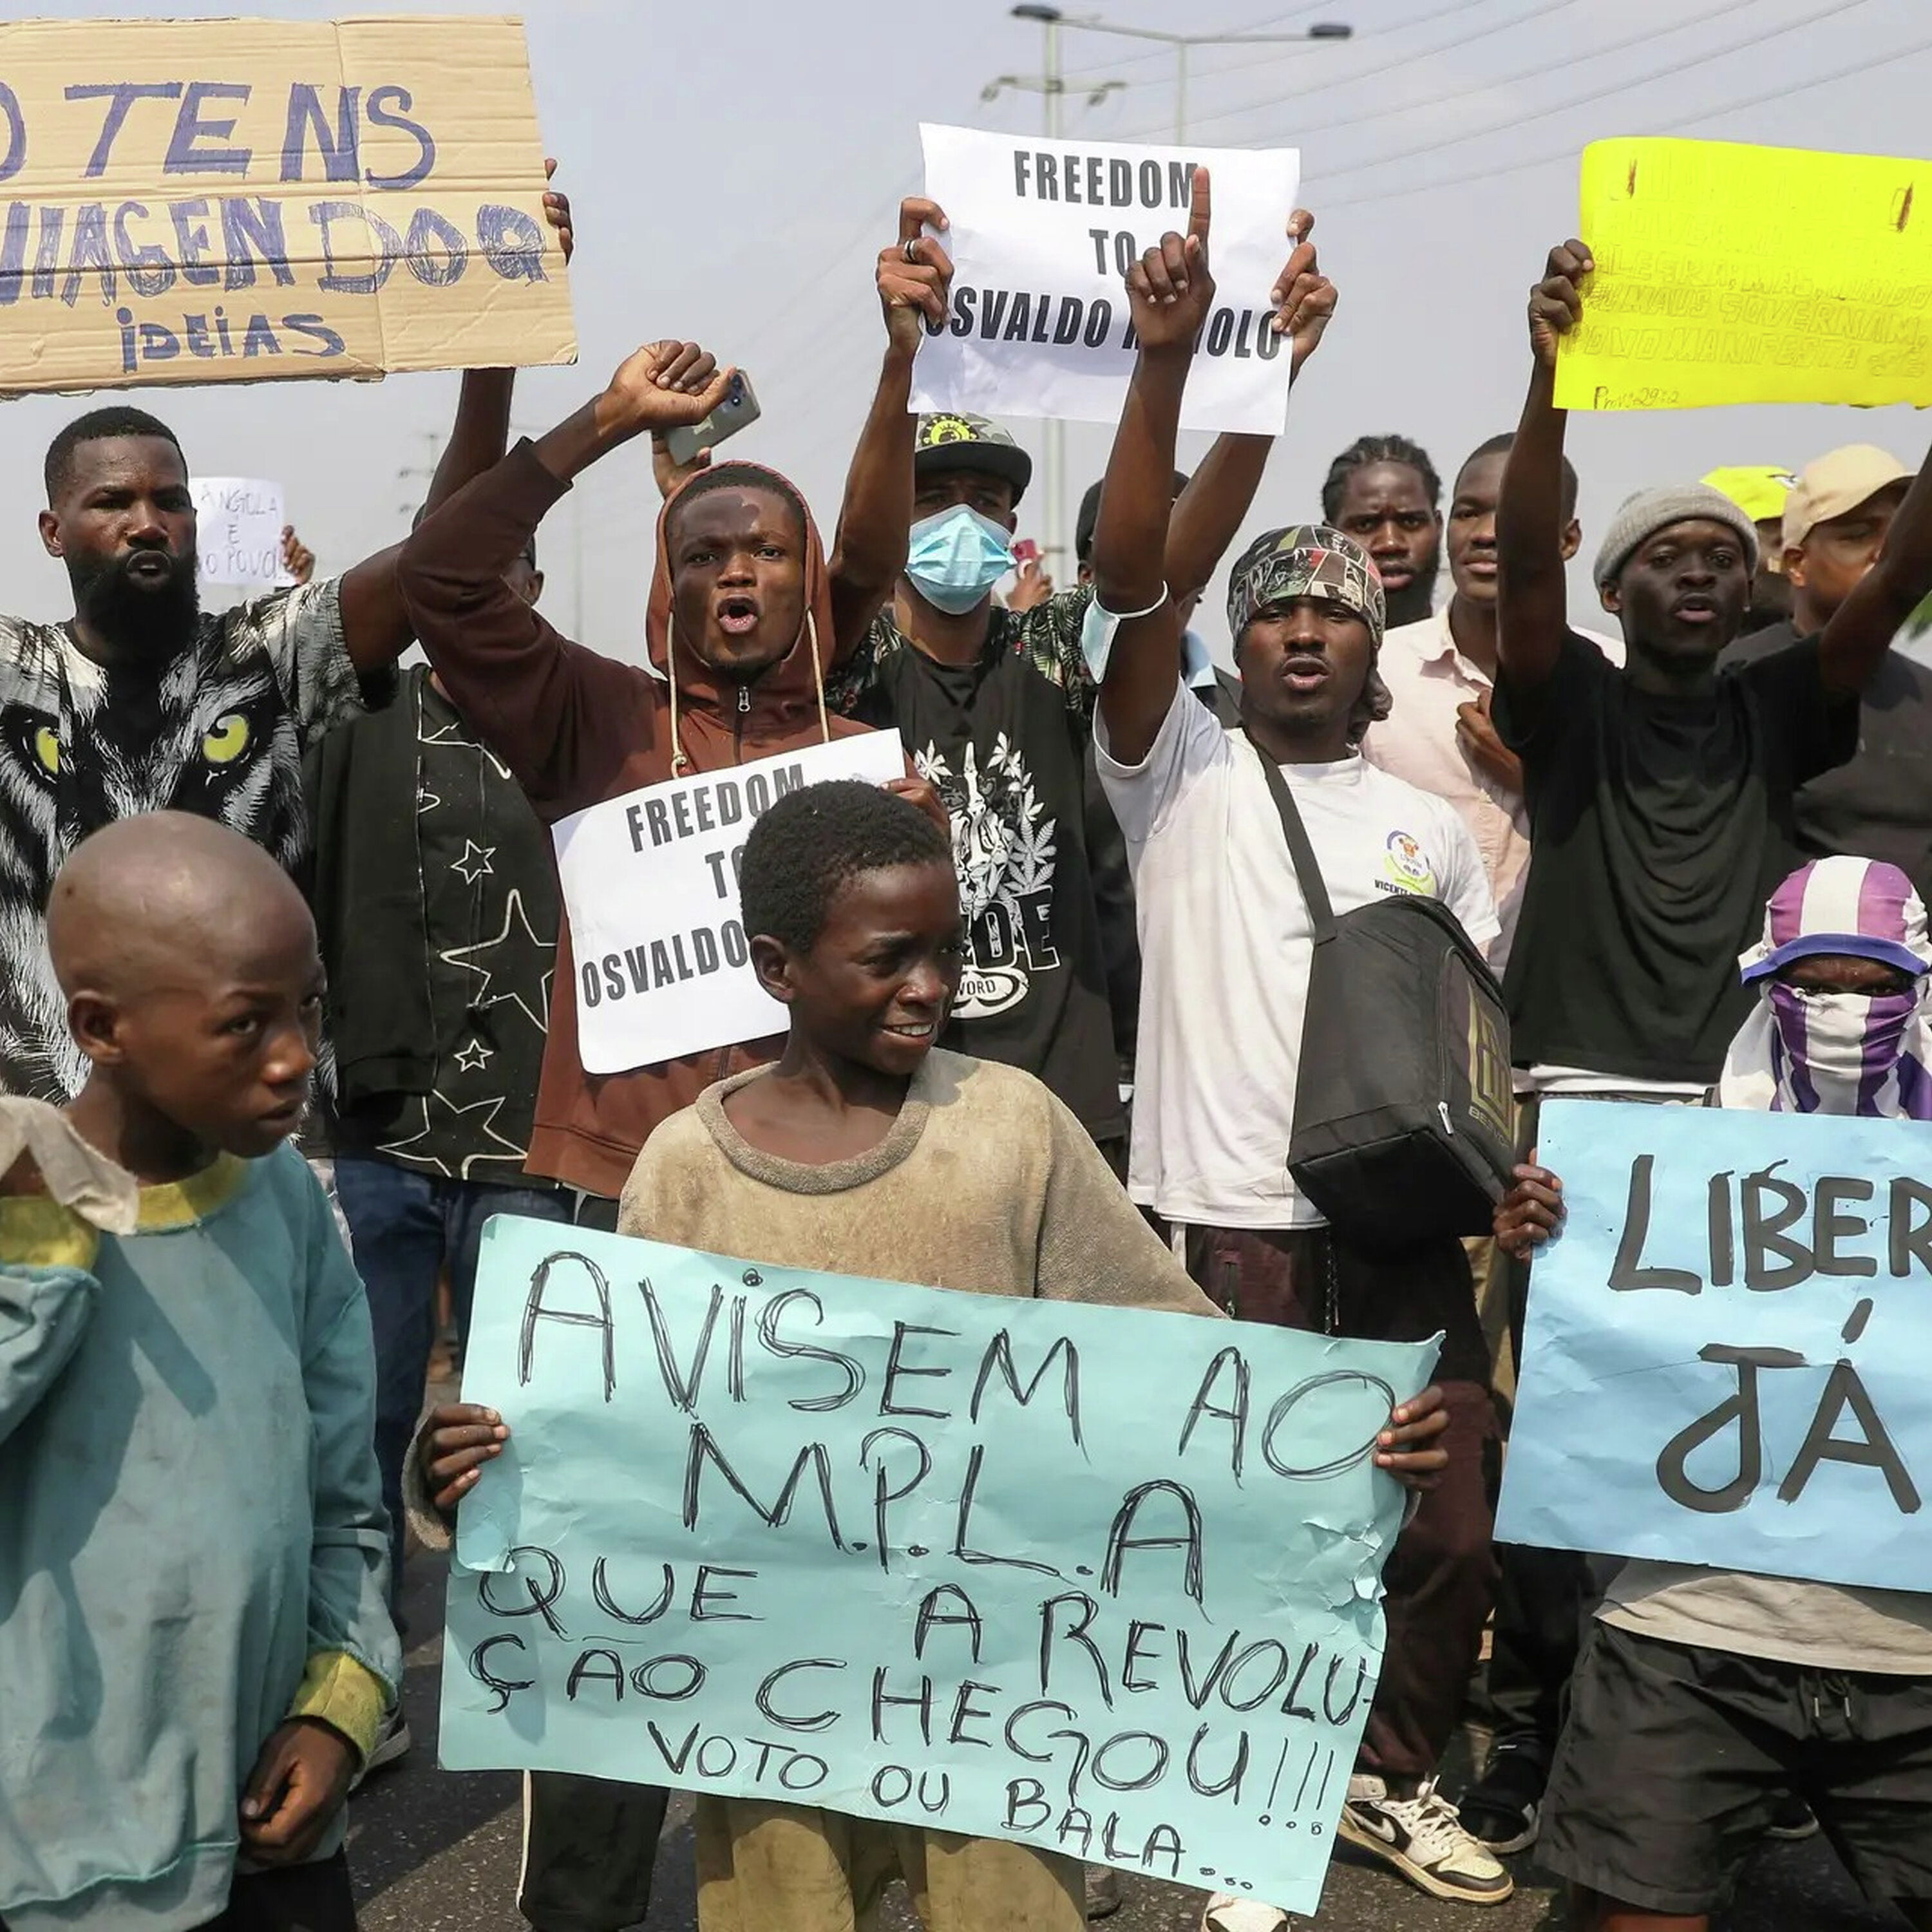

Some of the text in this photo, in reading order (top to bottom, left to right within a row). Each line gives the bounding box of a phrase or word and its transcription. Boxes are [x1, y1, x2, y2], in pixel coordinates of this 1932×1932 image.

[64, 82, 436, 189] TENS
[1014, 150, 1199, 209] FREEDOM
[1089, 229, 1137, 278] TO
[582, 920, 750, 1008] OSVALDO
[1178, 1346, 1396, 1490] AO
[1656, 1298, 1922, 1515] JÁ
[478, 1546, 765, 1643] QUE
[914, 1582, 984, 1665] A
[647, 1721, 829, 1791] VOTO
[871, 1763, 951, 1817] OU
